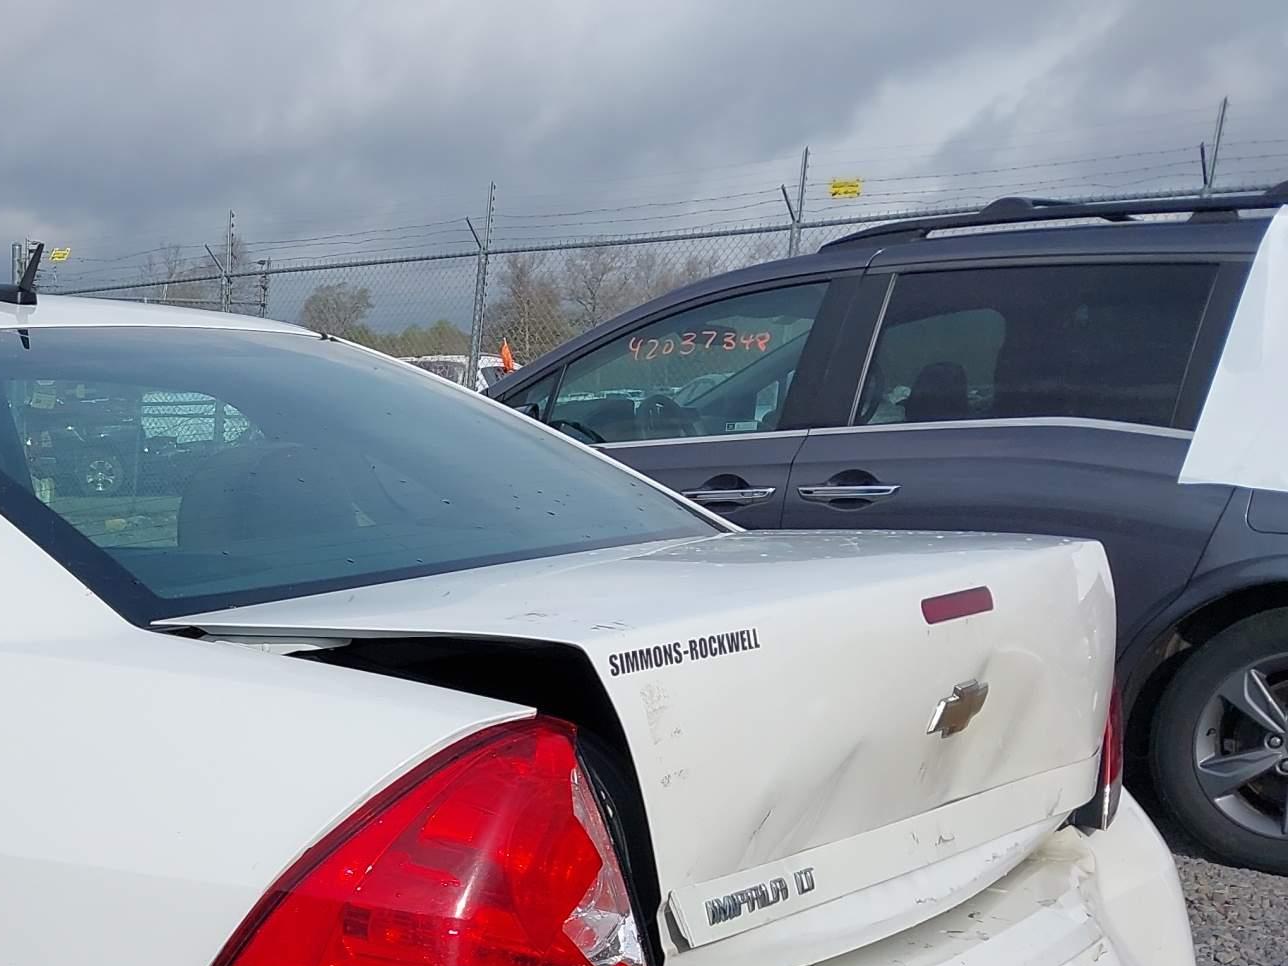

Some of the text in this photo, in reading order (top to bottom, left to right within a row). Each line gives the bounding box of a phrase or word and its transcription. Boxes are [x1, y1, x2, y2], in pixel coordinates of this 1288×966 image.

[629, 331, 770, 360] 42037348
[608, 627, 761, 677] SIMMONS-ROCKWELL
[704, 866, 815, 926] IMPALA LT
